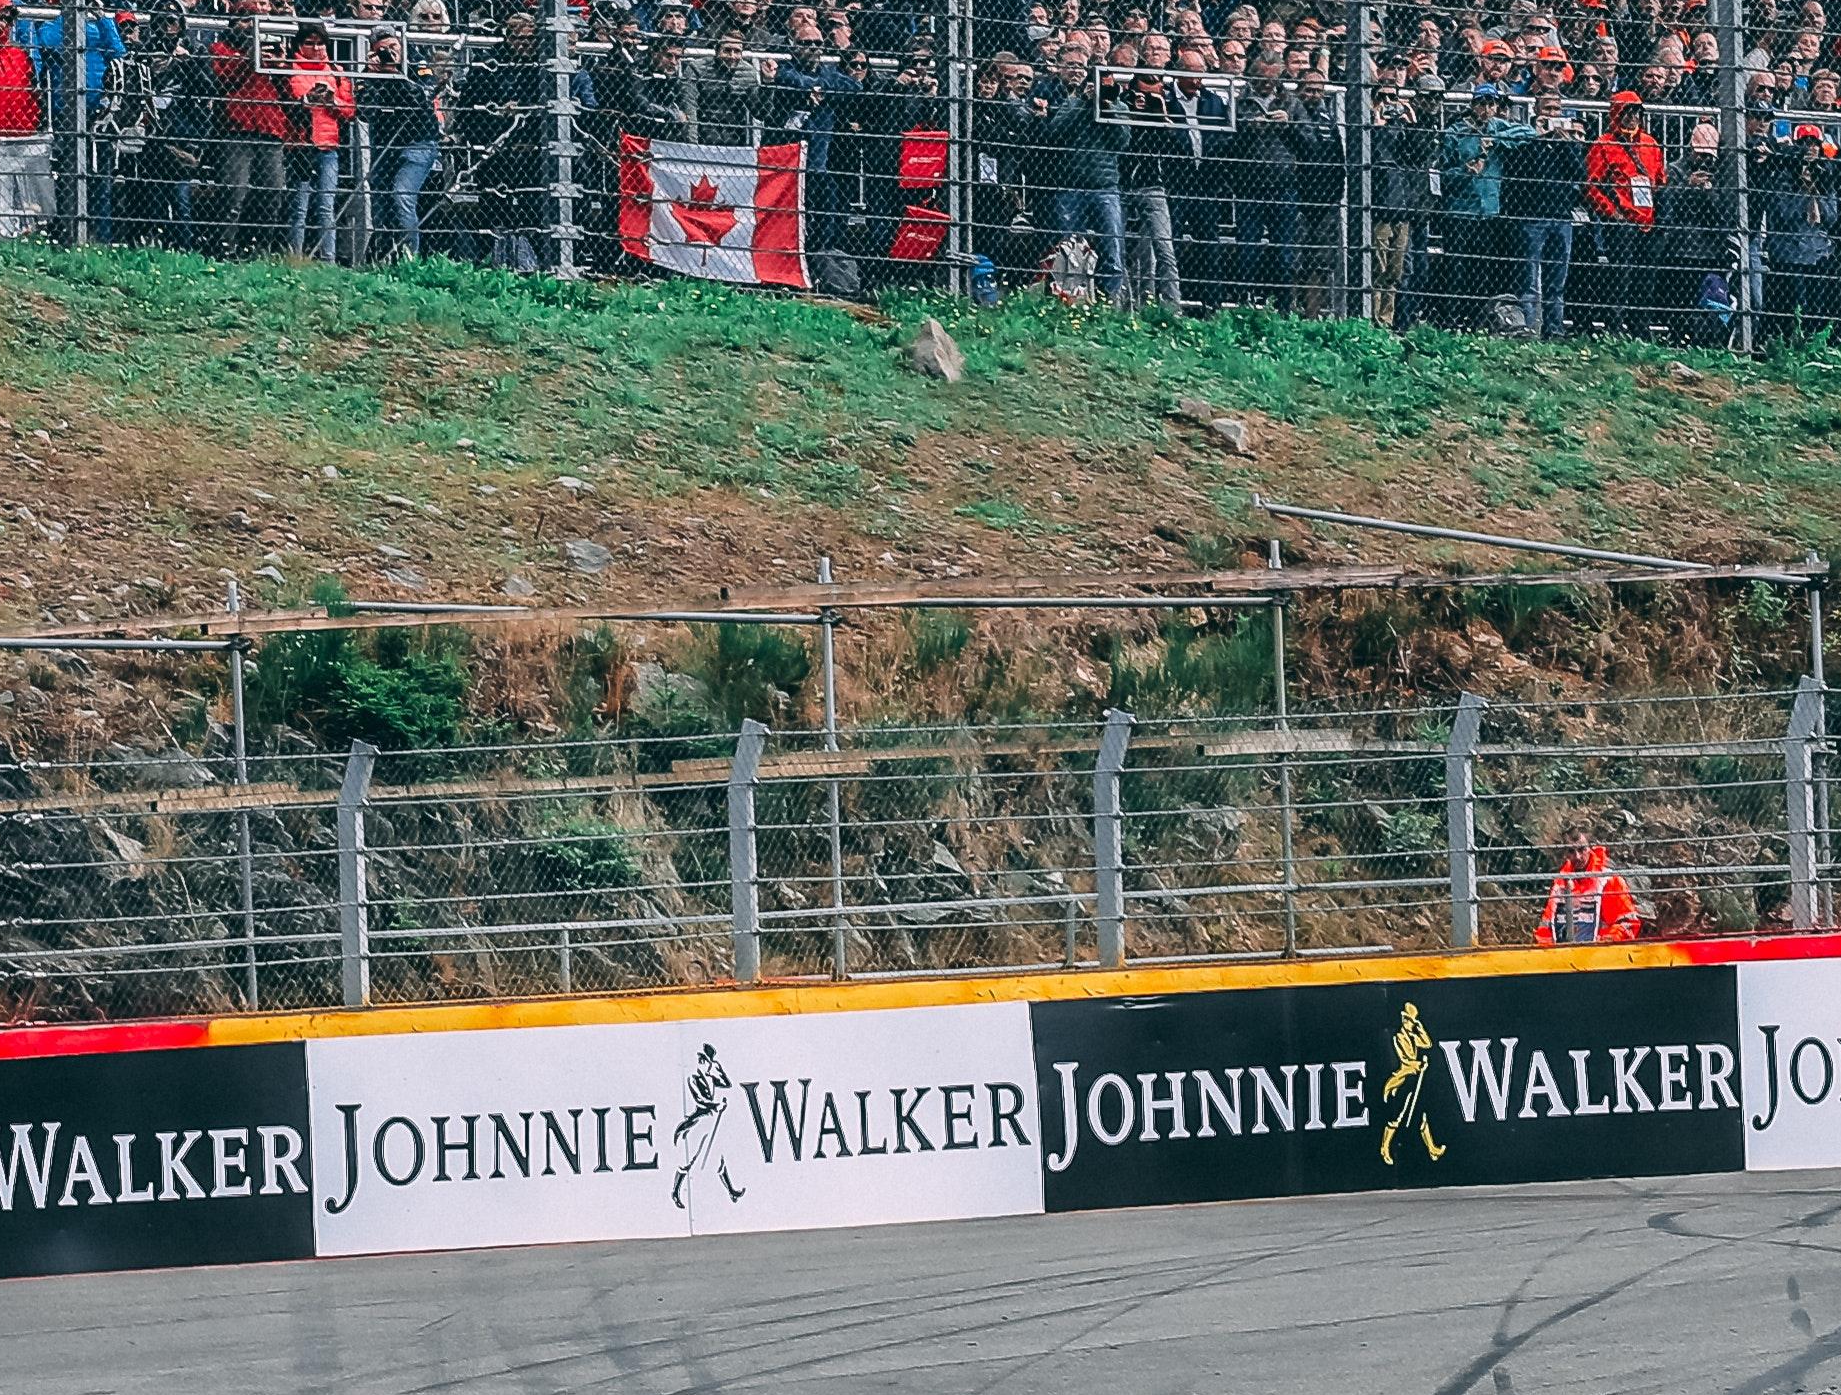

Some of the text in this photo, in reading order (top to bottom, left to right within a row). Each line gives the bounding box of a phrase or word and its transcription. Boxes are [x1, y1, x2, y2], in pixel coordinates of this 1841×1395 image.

[325, 1079, 1031, 1214] JOHNNIE WALKER
[1048, 1037, 1741, 1171] JOHNNIE WALKER
